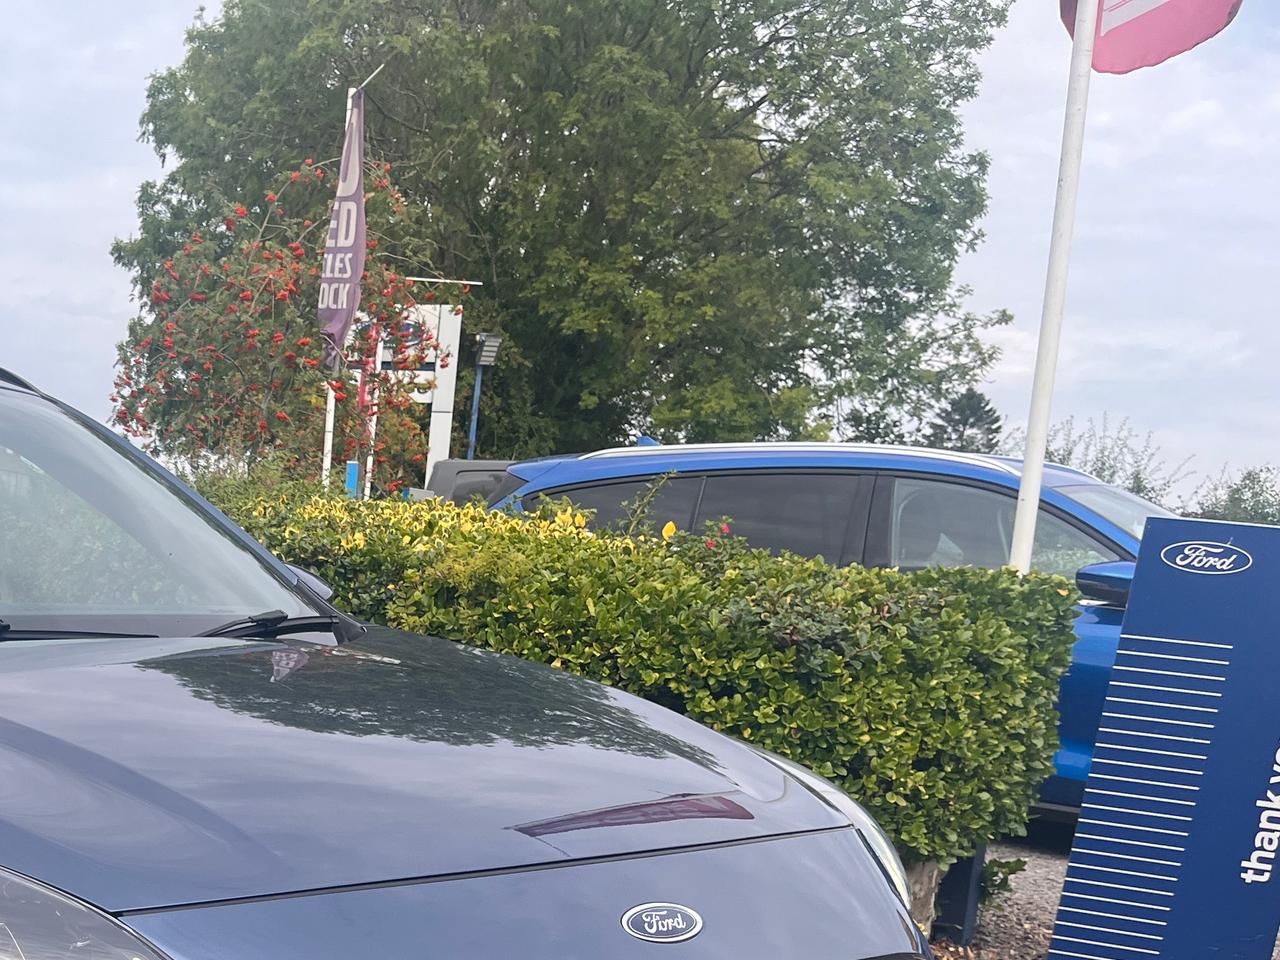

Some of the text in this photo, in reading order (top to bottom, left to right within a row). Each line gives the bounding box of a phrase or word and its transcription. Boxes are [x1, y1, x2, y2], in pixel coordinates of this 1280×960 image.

[1175, 544, 1238, 570] Ford
[1240, 789, 1280, 884] thank
[641, 910, 687, 934] Ford
